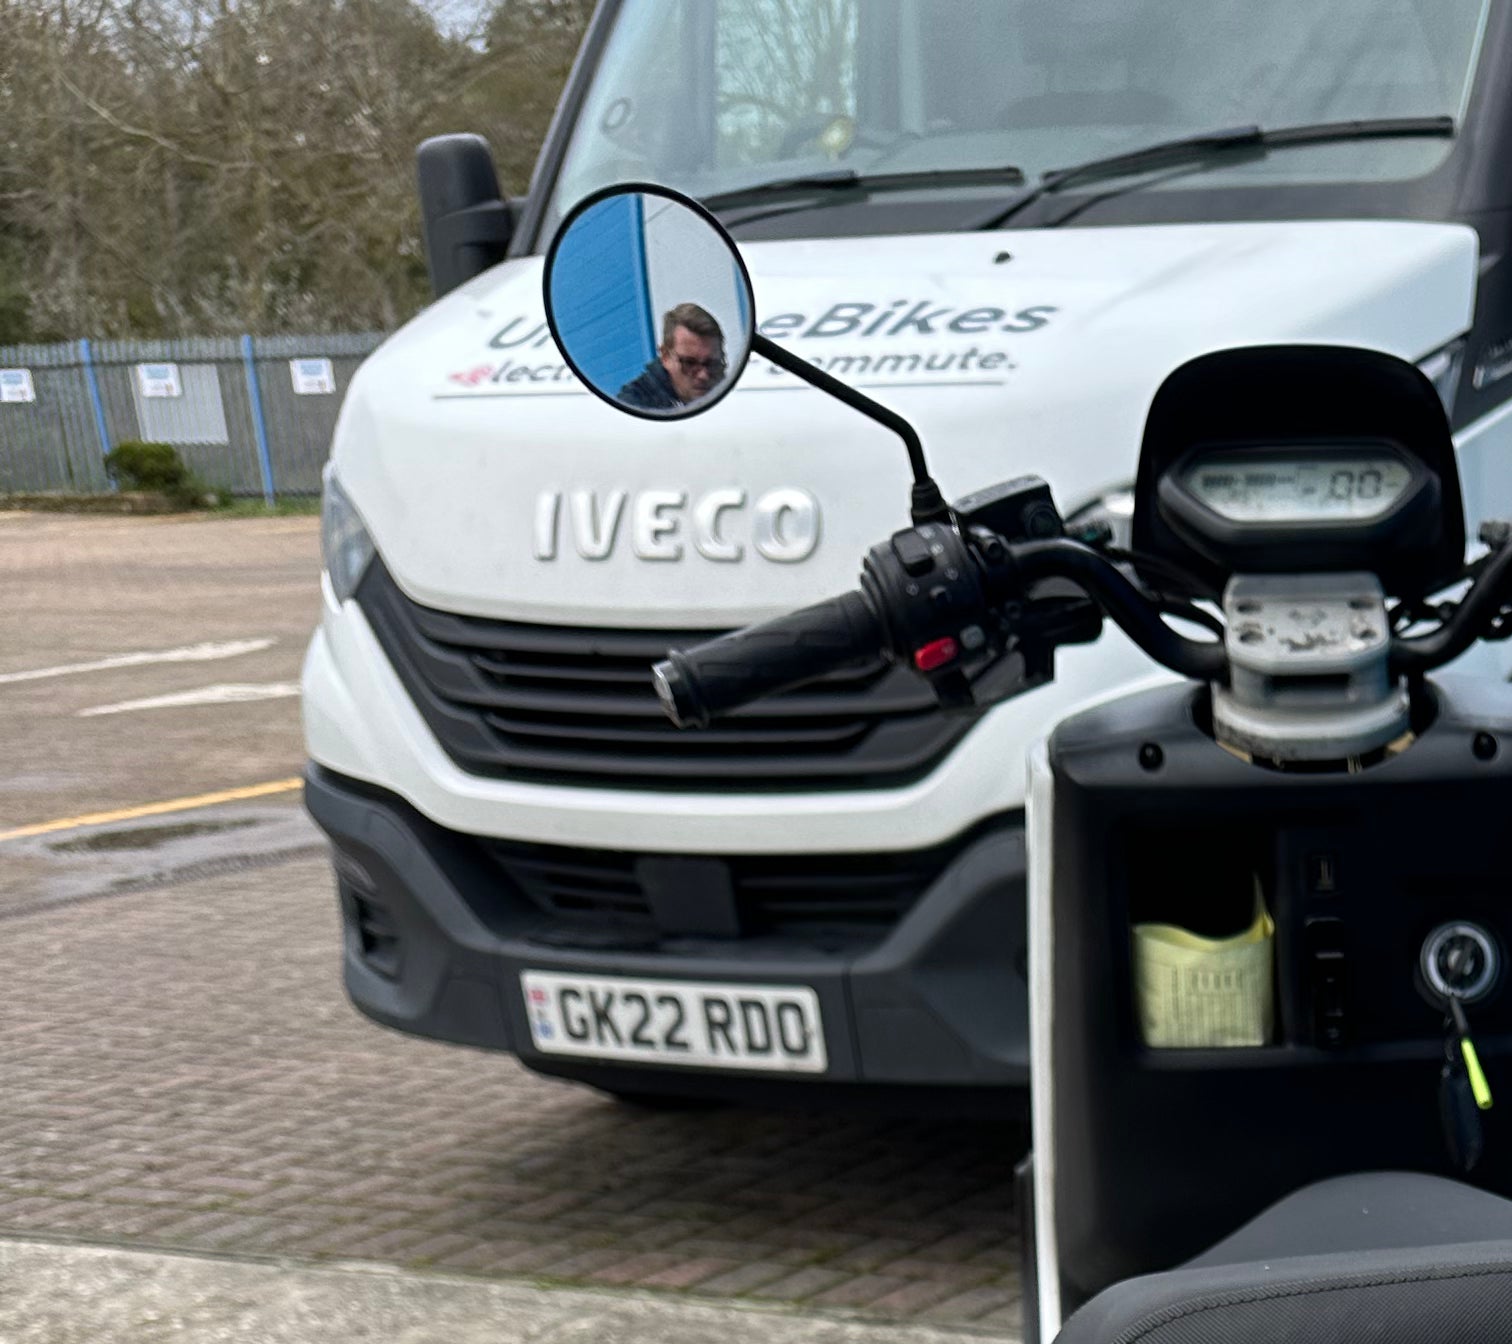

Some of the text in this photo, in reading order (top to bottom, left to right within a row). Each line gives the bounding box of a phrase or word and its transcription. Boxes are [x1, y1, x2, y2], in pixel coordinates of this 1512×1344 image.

[759, 299, 1060, 339] eBikes
[534, 484, 823, 563] IVECO
[558, 987, 810, 1057] GK22 RDO
